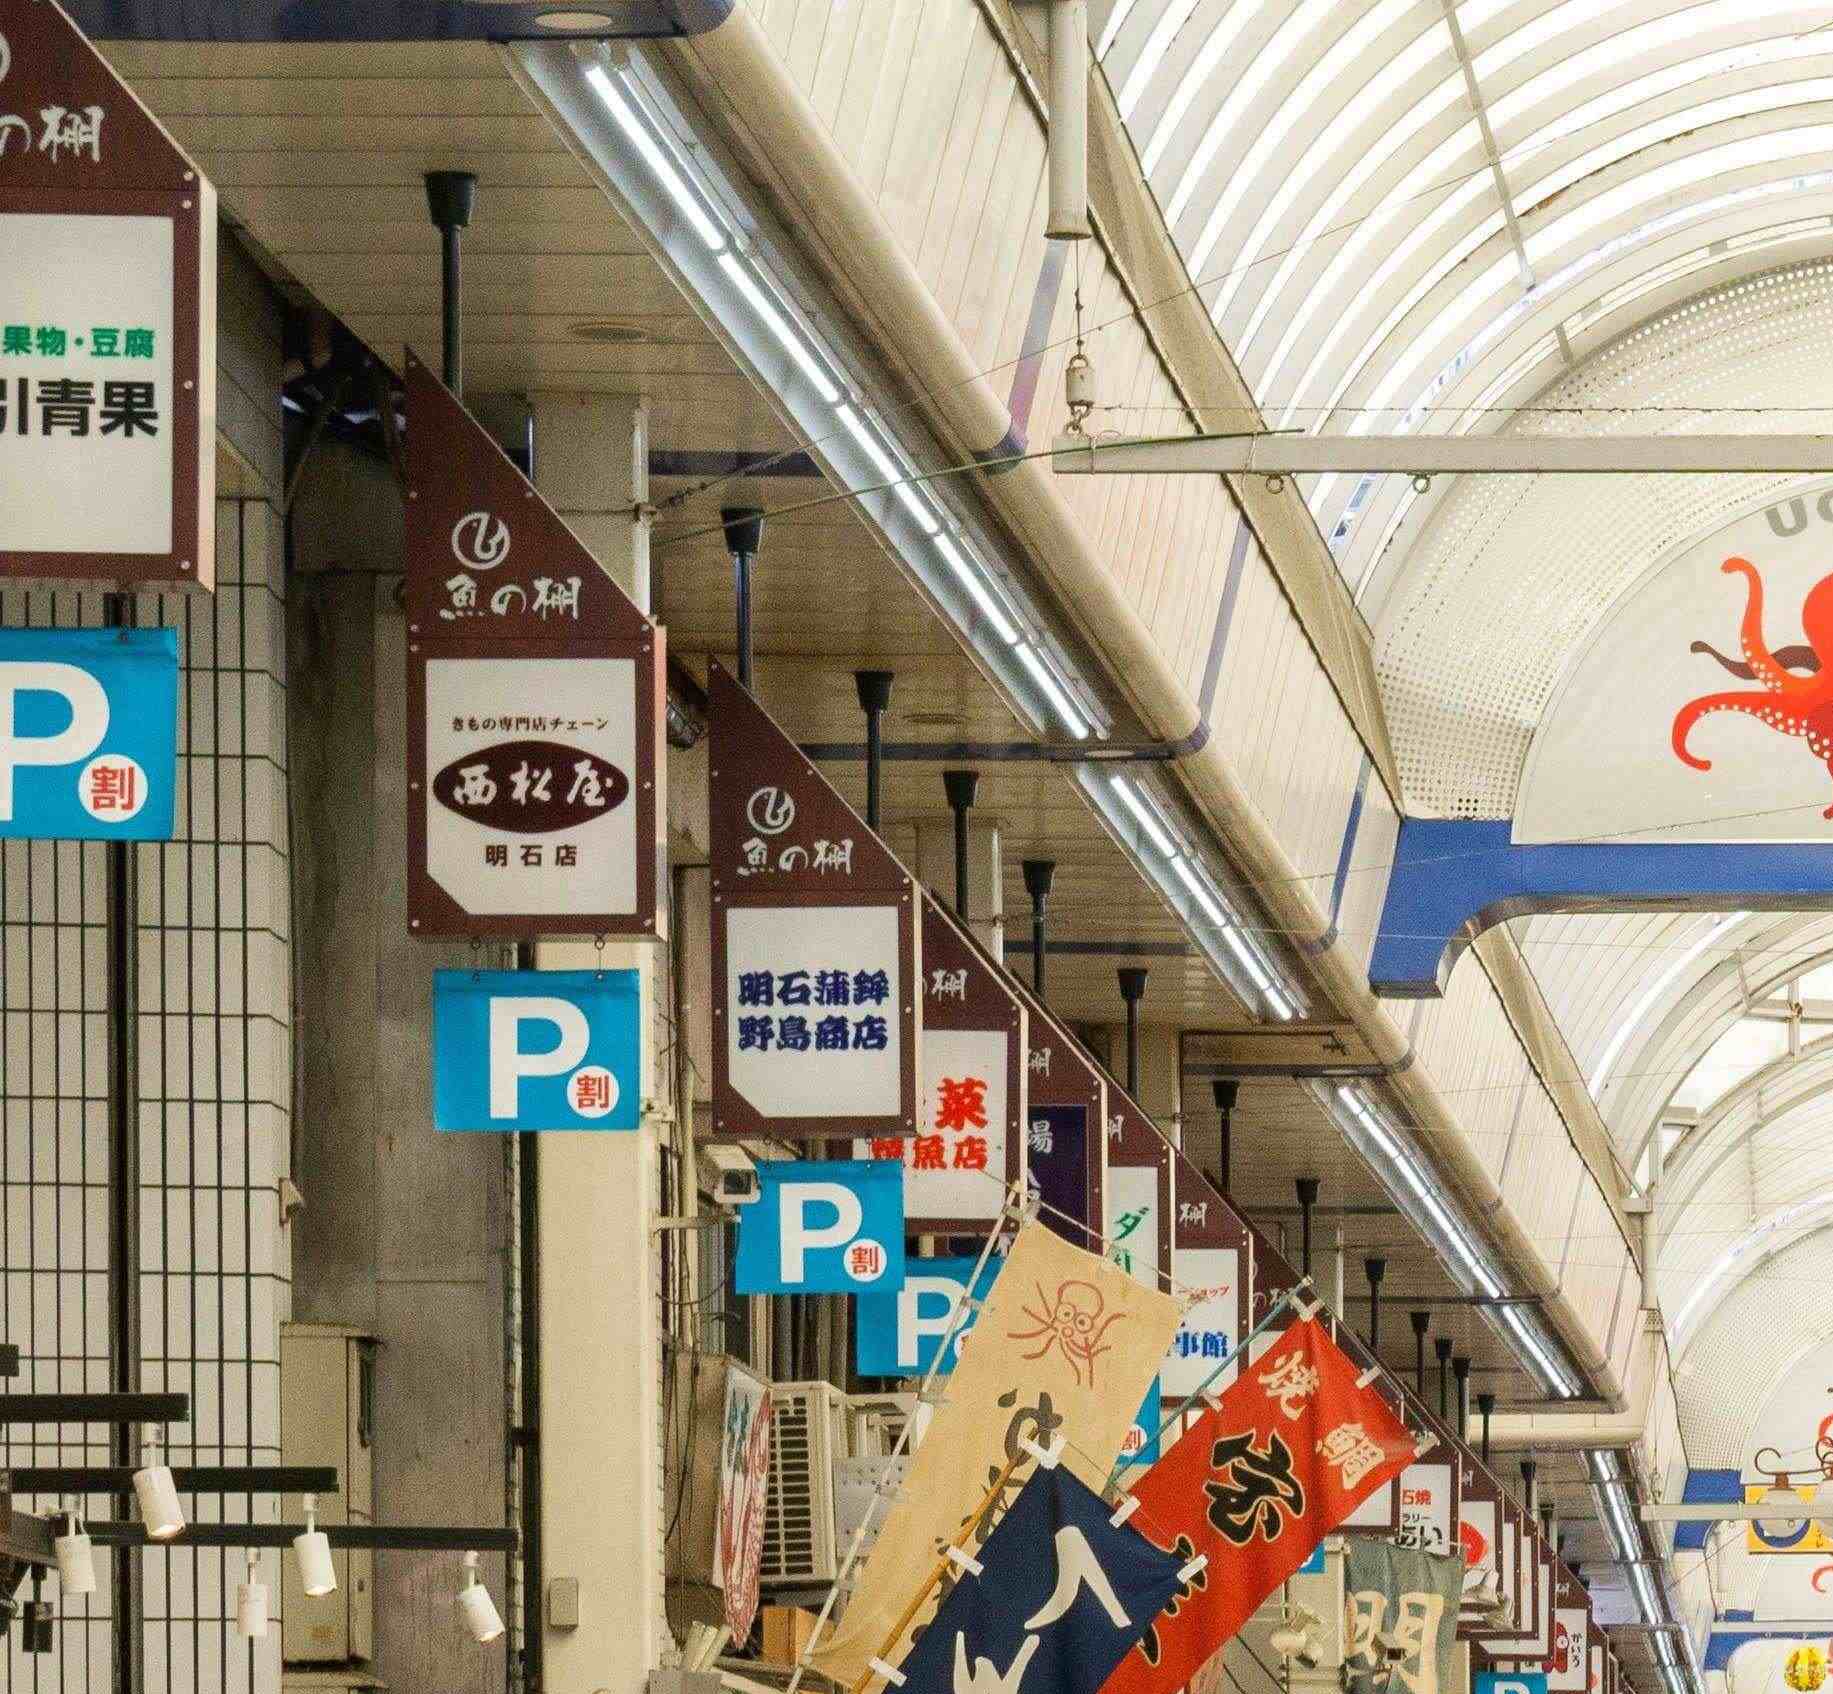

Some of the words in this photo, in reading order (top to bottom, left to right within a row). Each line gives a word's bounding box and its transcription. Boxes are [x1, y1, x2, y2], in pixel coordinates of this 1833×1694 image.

[439, 574, 583, 621] 魚の棚
[0, 661, 109, 820] P
[452, 716, 609, 732] きもの専門店チェーン
[91, 765, 134, 809] 割
[485, 844, 577, 867] 明石店
[736, 840, 853, 876] 魚の棚
[737, 969, 890, 1006] 明石蒲鉾
[737, 1015, 890, 1052] 野島商店
[490, 996, 590, 1119] P
[577, 1074, 609, 1109] 割
[779, 1182, 863, 1283] P
[851, 1244, 880, 1275] 割
[897, 1276, 968, 1367] P
